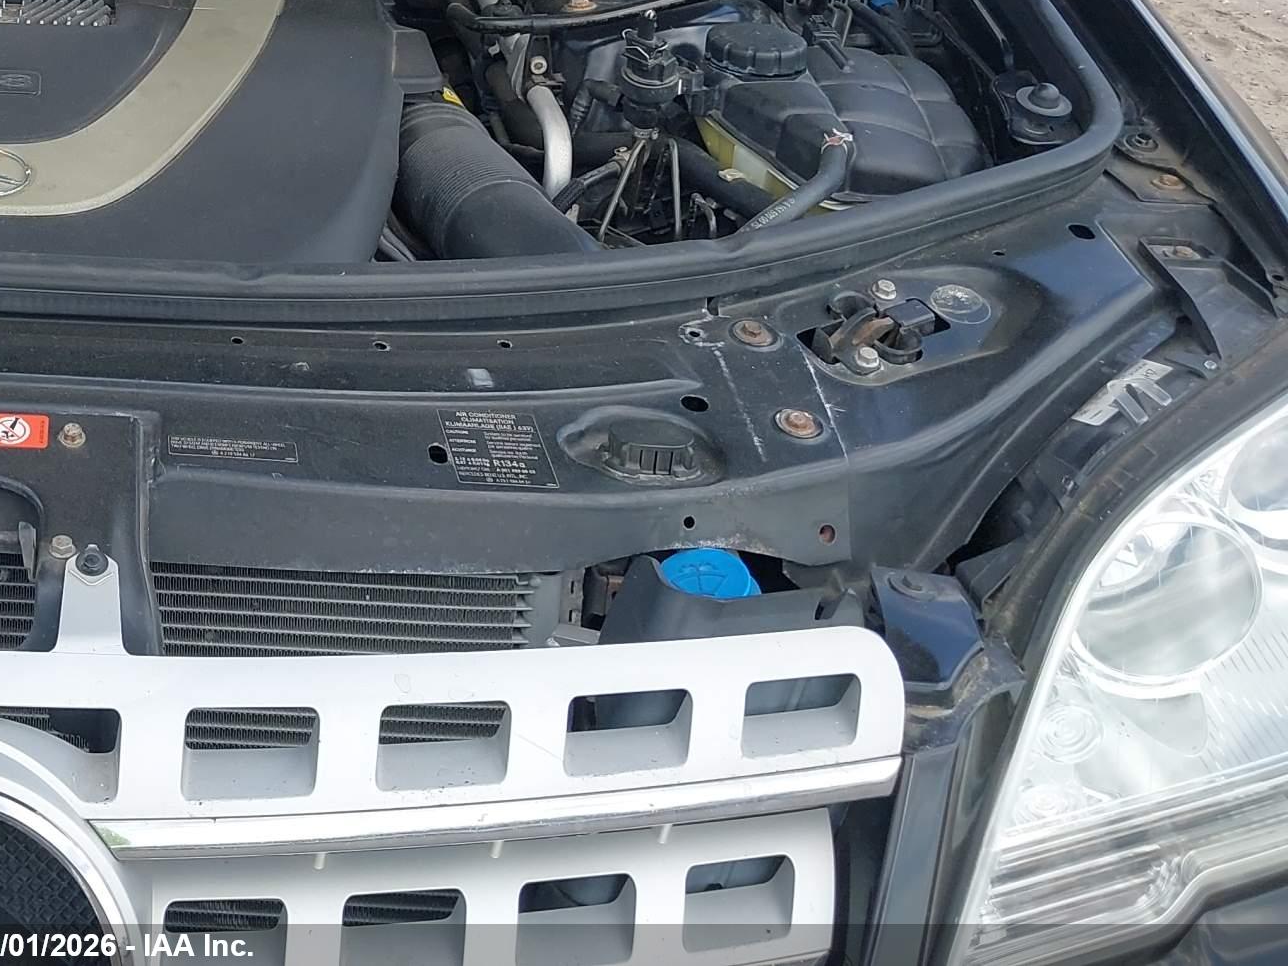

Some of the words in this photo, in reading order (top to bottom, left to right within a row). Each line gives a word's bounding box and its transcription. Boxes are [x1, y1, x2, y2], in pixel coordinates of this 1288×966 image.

[468, 412, 516, 420] CONDITIONER
[445, 421, 495, 429] KLIMAANLAGE
[461, 417, 514, 425] CLIMATISATION
[493, 460, 526, 468] R134a
